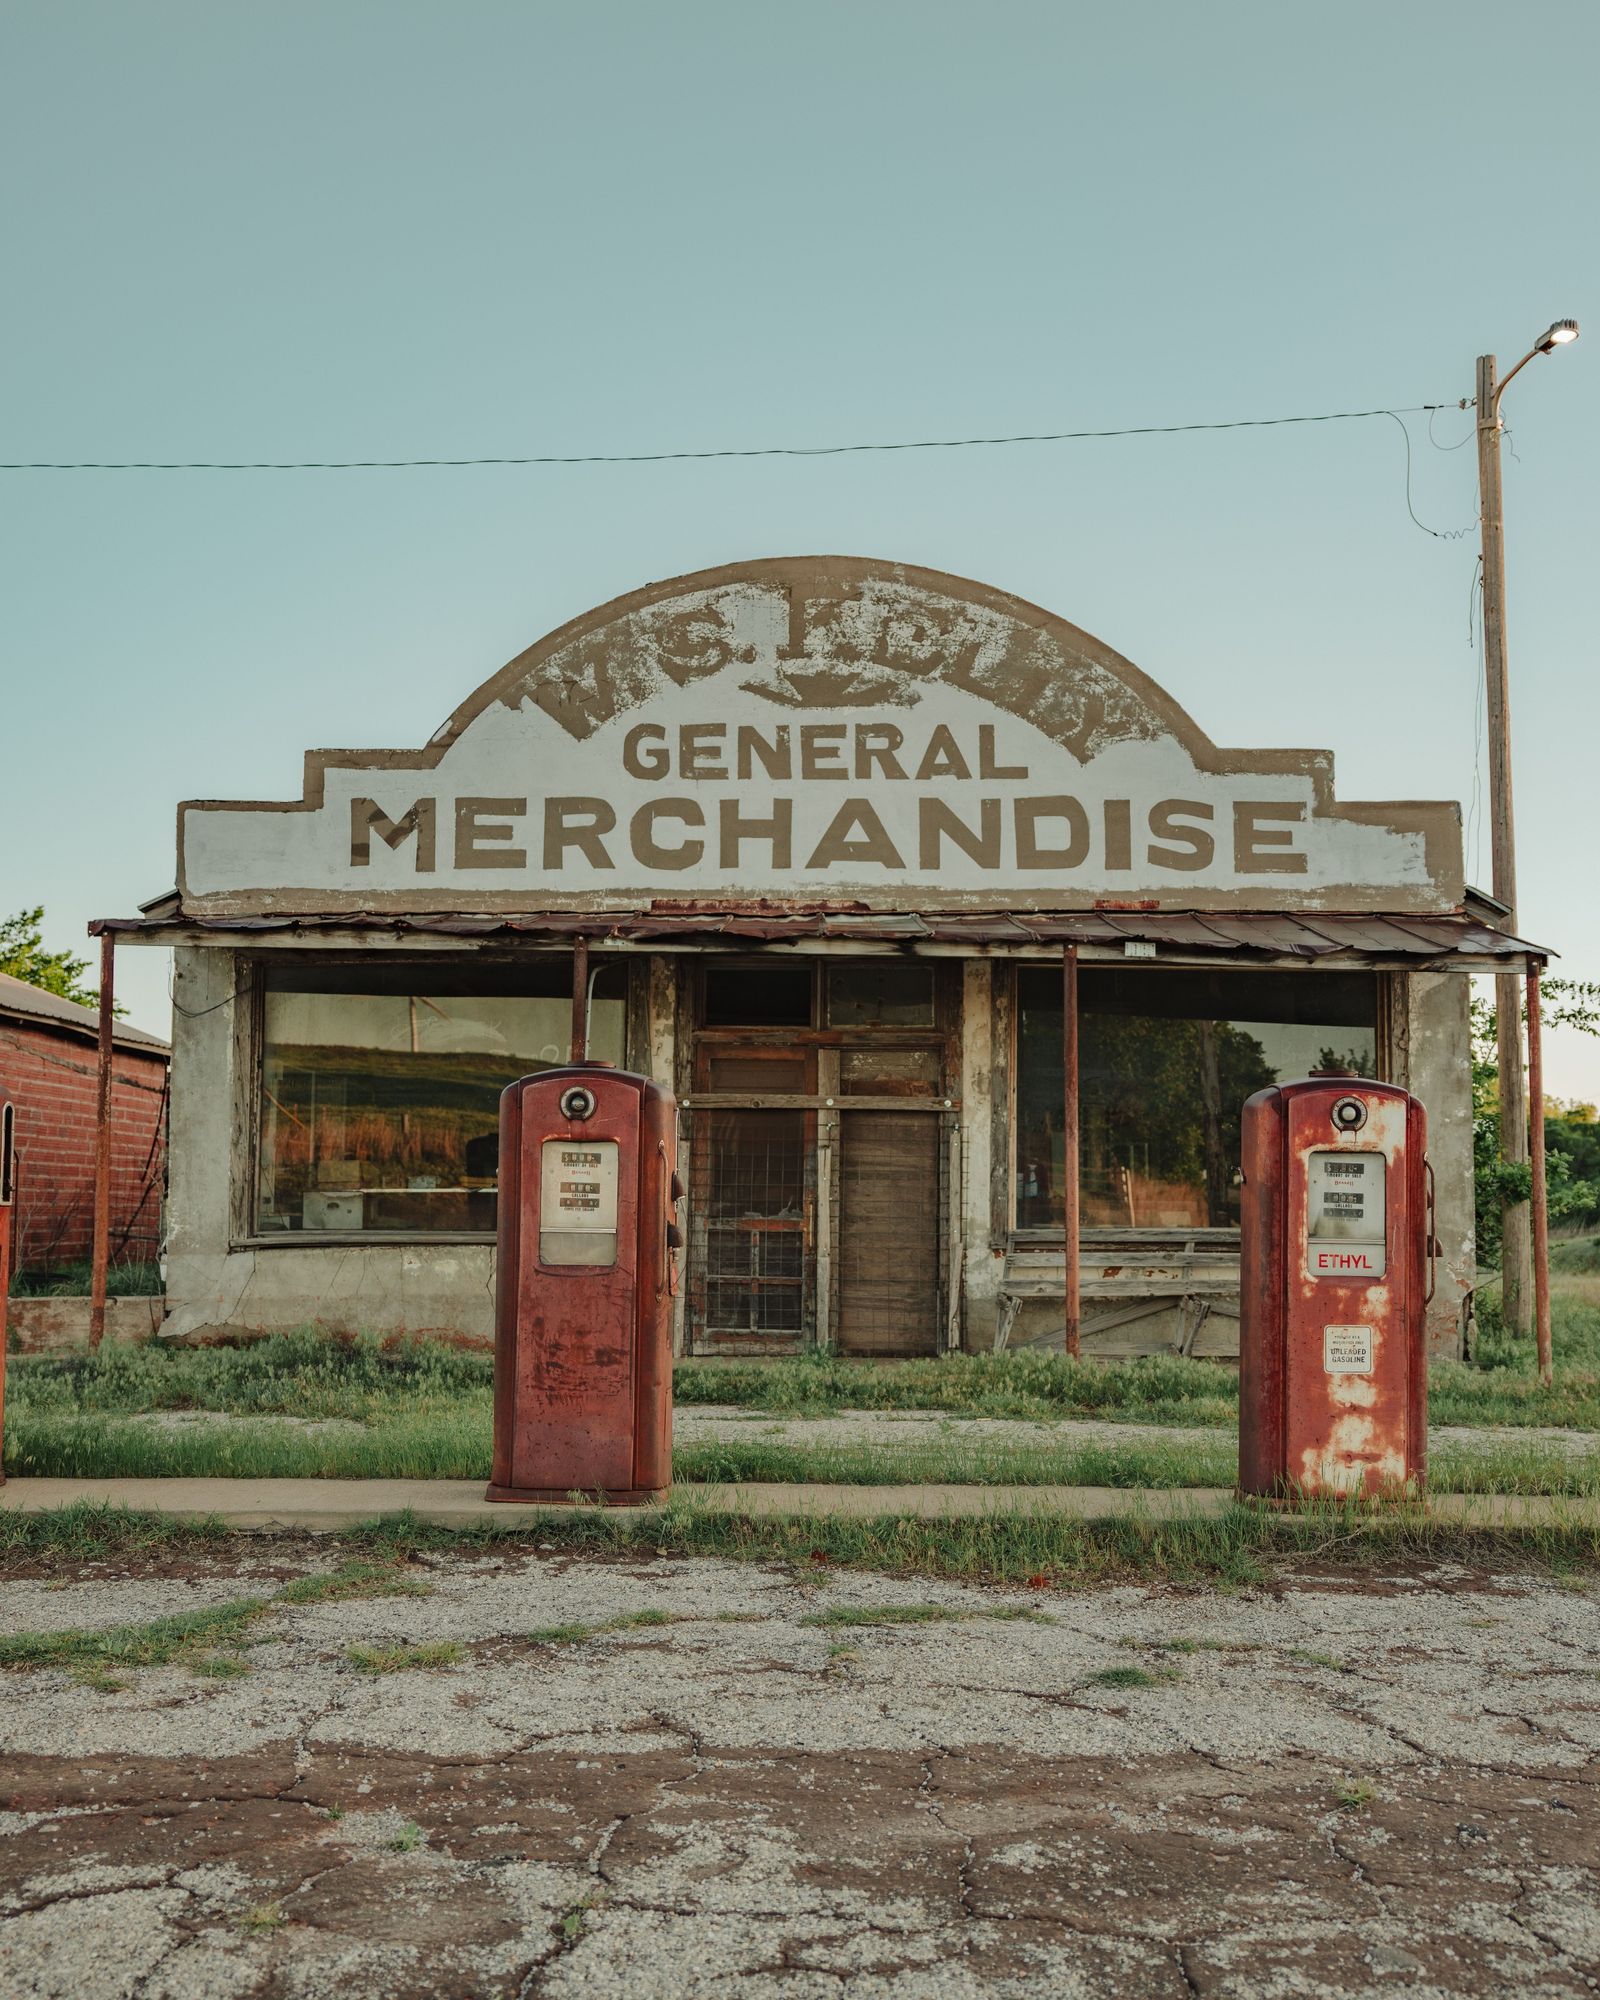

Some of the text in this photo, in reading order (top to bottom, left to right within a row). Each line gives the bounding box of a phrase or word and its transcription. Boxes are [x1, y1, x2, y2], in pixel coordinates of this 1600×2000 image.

[623, 723, 1029, 780] GENERAL
[350, 795, 1308, 873] MERCHANDISE
[1318, 1253, 1373, 1269] ETHYL
